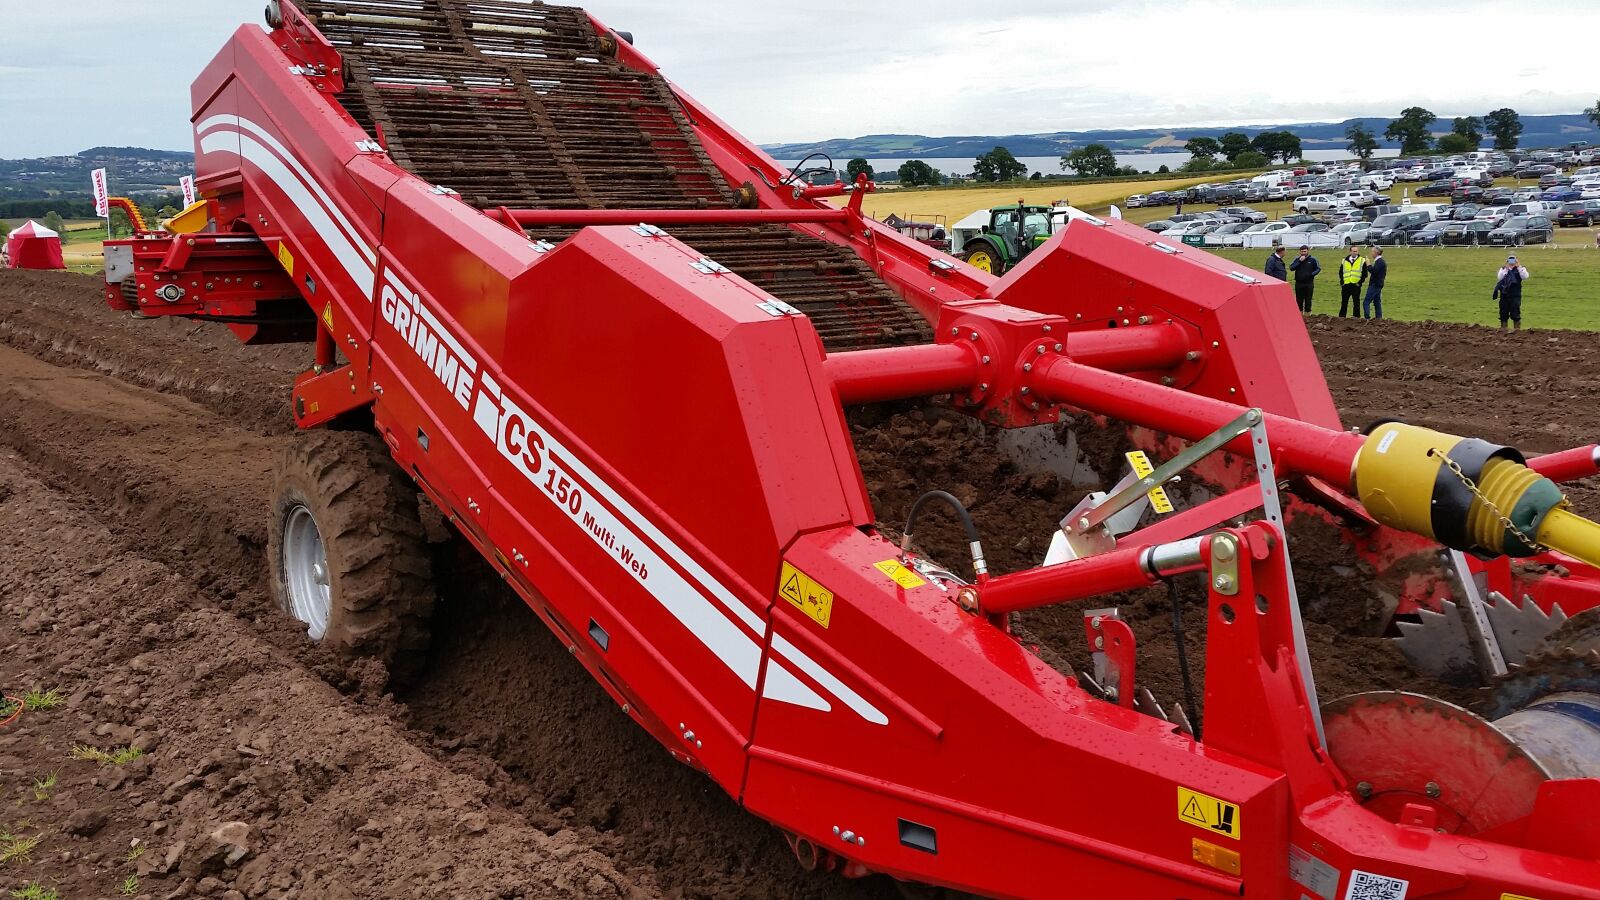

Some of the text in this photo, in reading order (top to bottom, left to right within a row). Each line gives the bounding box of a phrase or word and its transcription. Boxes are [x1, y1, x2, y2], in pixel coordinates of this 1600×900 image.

[381, 284, 474, 412] GRIMME
[505, 414, 545, 474] CS
[543, 468, 583, 515] 150
